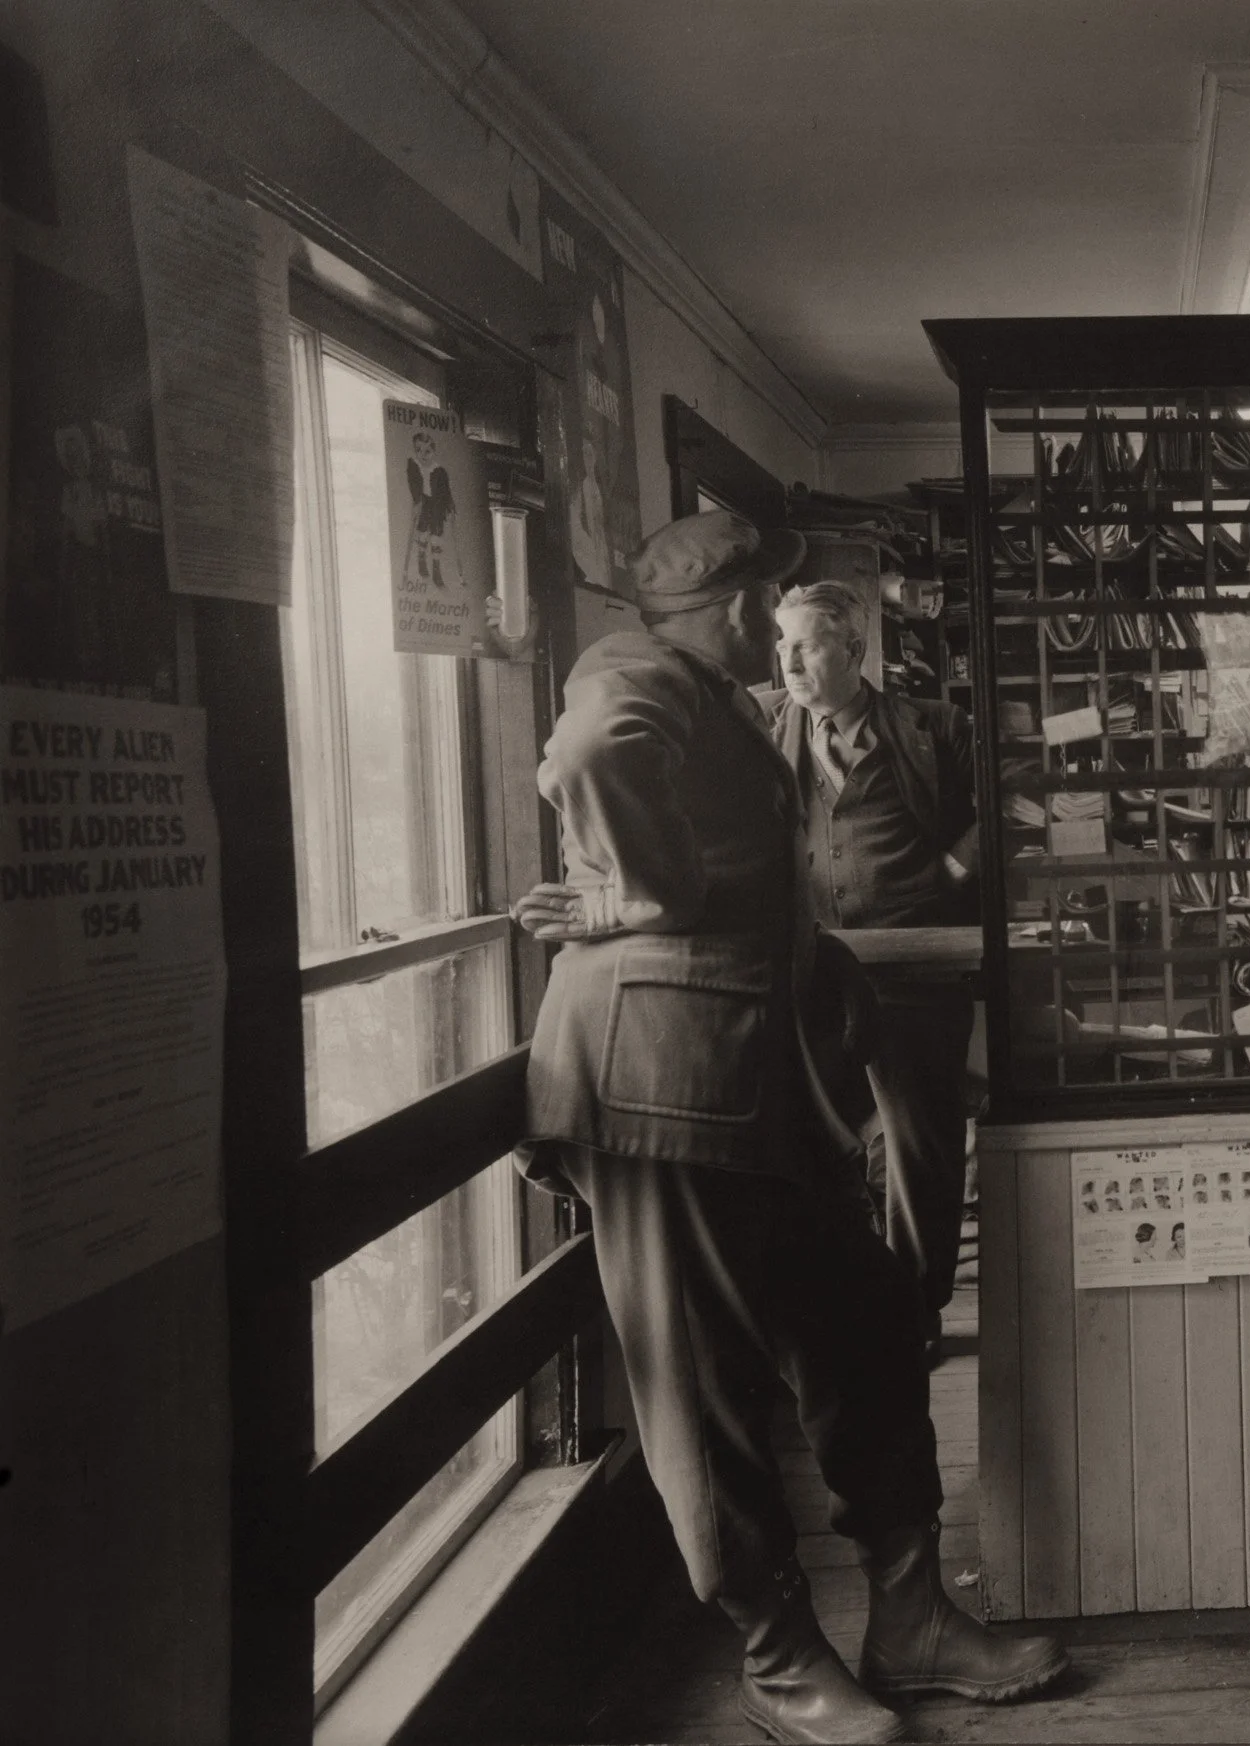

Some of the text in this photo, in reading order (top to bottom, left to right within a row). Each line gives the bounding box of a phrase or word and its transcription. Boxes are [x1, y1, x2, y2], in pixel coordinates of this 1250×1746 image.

[387, 405, 457, 434] HELP NOW!
[397, 577, 427, 595] Join
[398, 596, 470, 619] the March
[398, 616, 462, 637] of Dimes
[9, 719, 176, 763] EVERY ALIEN
[0, 767, 185, 805] MUST REPORT
[18, 814, 187, 852] HIS ADDRESS
[0, 854, 207, 901] DURING JANUARY
[81, 901, 143, 939] 1954
